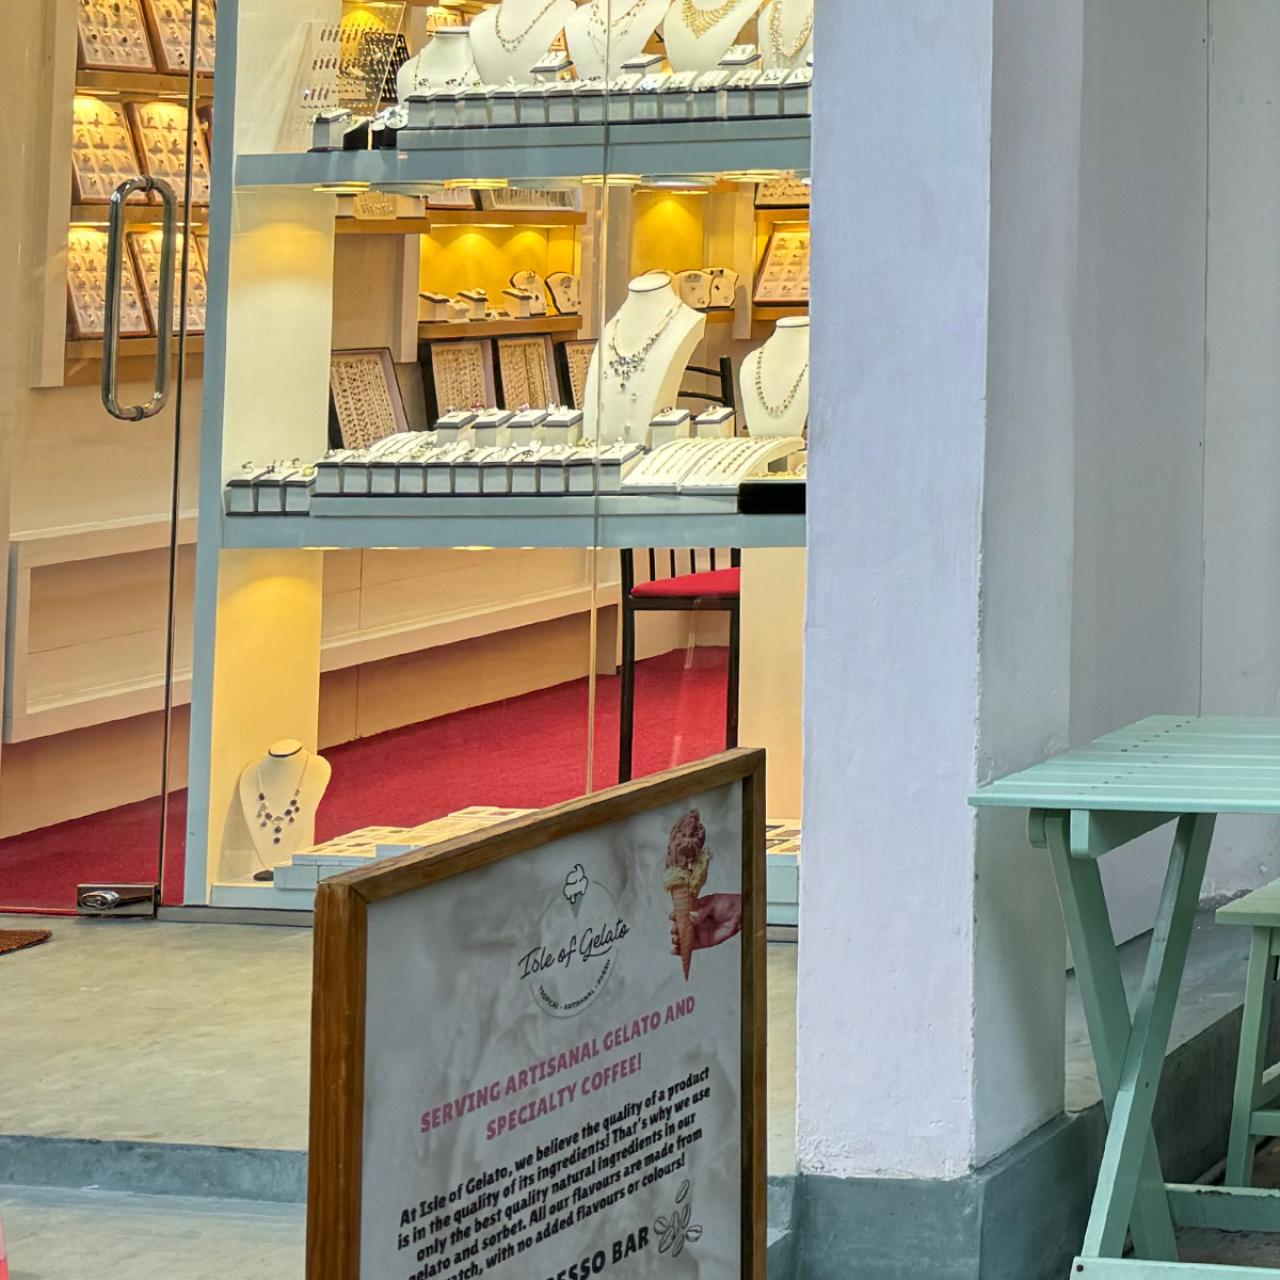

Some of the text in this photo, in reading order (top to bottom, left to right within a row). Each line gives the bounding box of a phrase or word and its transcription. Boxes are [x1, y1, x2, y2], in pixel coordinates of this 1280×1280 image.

[518, 917, 630, 980] Isle of Gelato
[420, 995, 695, 1134] SERVING ARTISANAL GELATO AND
[486, 1052, 642, 1141] SPECIALTY COFFEE!
[397, 1087, 711, 1251] is in the quality of its ingredients! That's why we use
[400, 1066, 709, 1228] At Isle of Gelato, we believe the quality of a product
[416, 1112, 696, 1262] only the best quality natural ingredients in our
[453, 1238, 479, 1264] and
[481, 1218, 527, 1251] sorbet.
[529, 1204, 546, 1226] All
[548, 1196, 570, 1215] our
[572, 1170, 621, 1204] flavours
[623, 1159, 642, 1177] are
[644, 1142, 674, 1167] made
[677, 1128, 703, 1151] from
[485, 1243, 515, 1269] with
[517, 1236, 533, 1253] no
[535, 1211, 574, 1243] added
[576, 1188, 625, 1222] flavours
[627, 1180, 640, 1194] or
[642, 1152, 685, 1187] colours!
[611, 1226, 649, 1265] BAR
